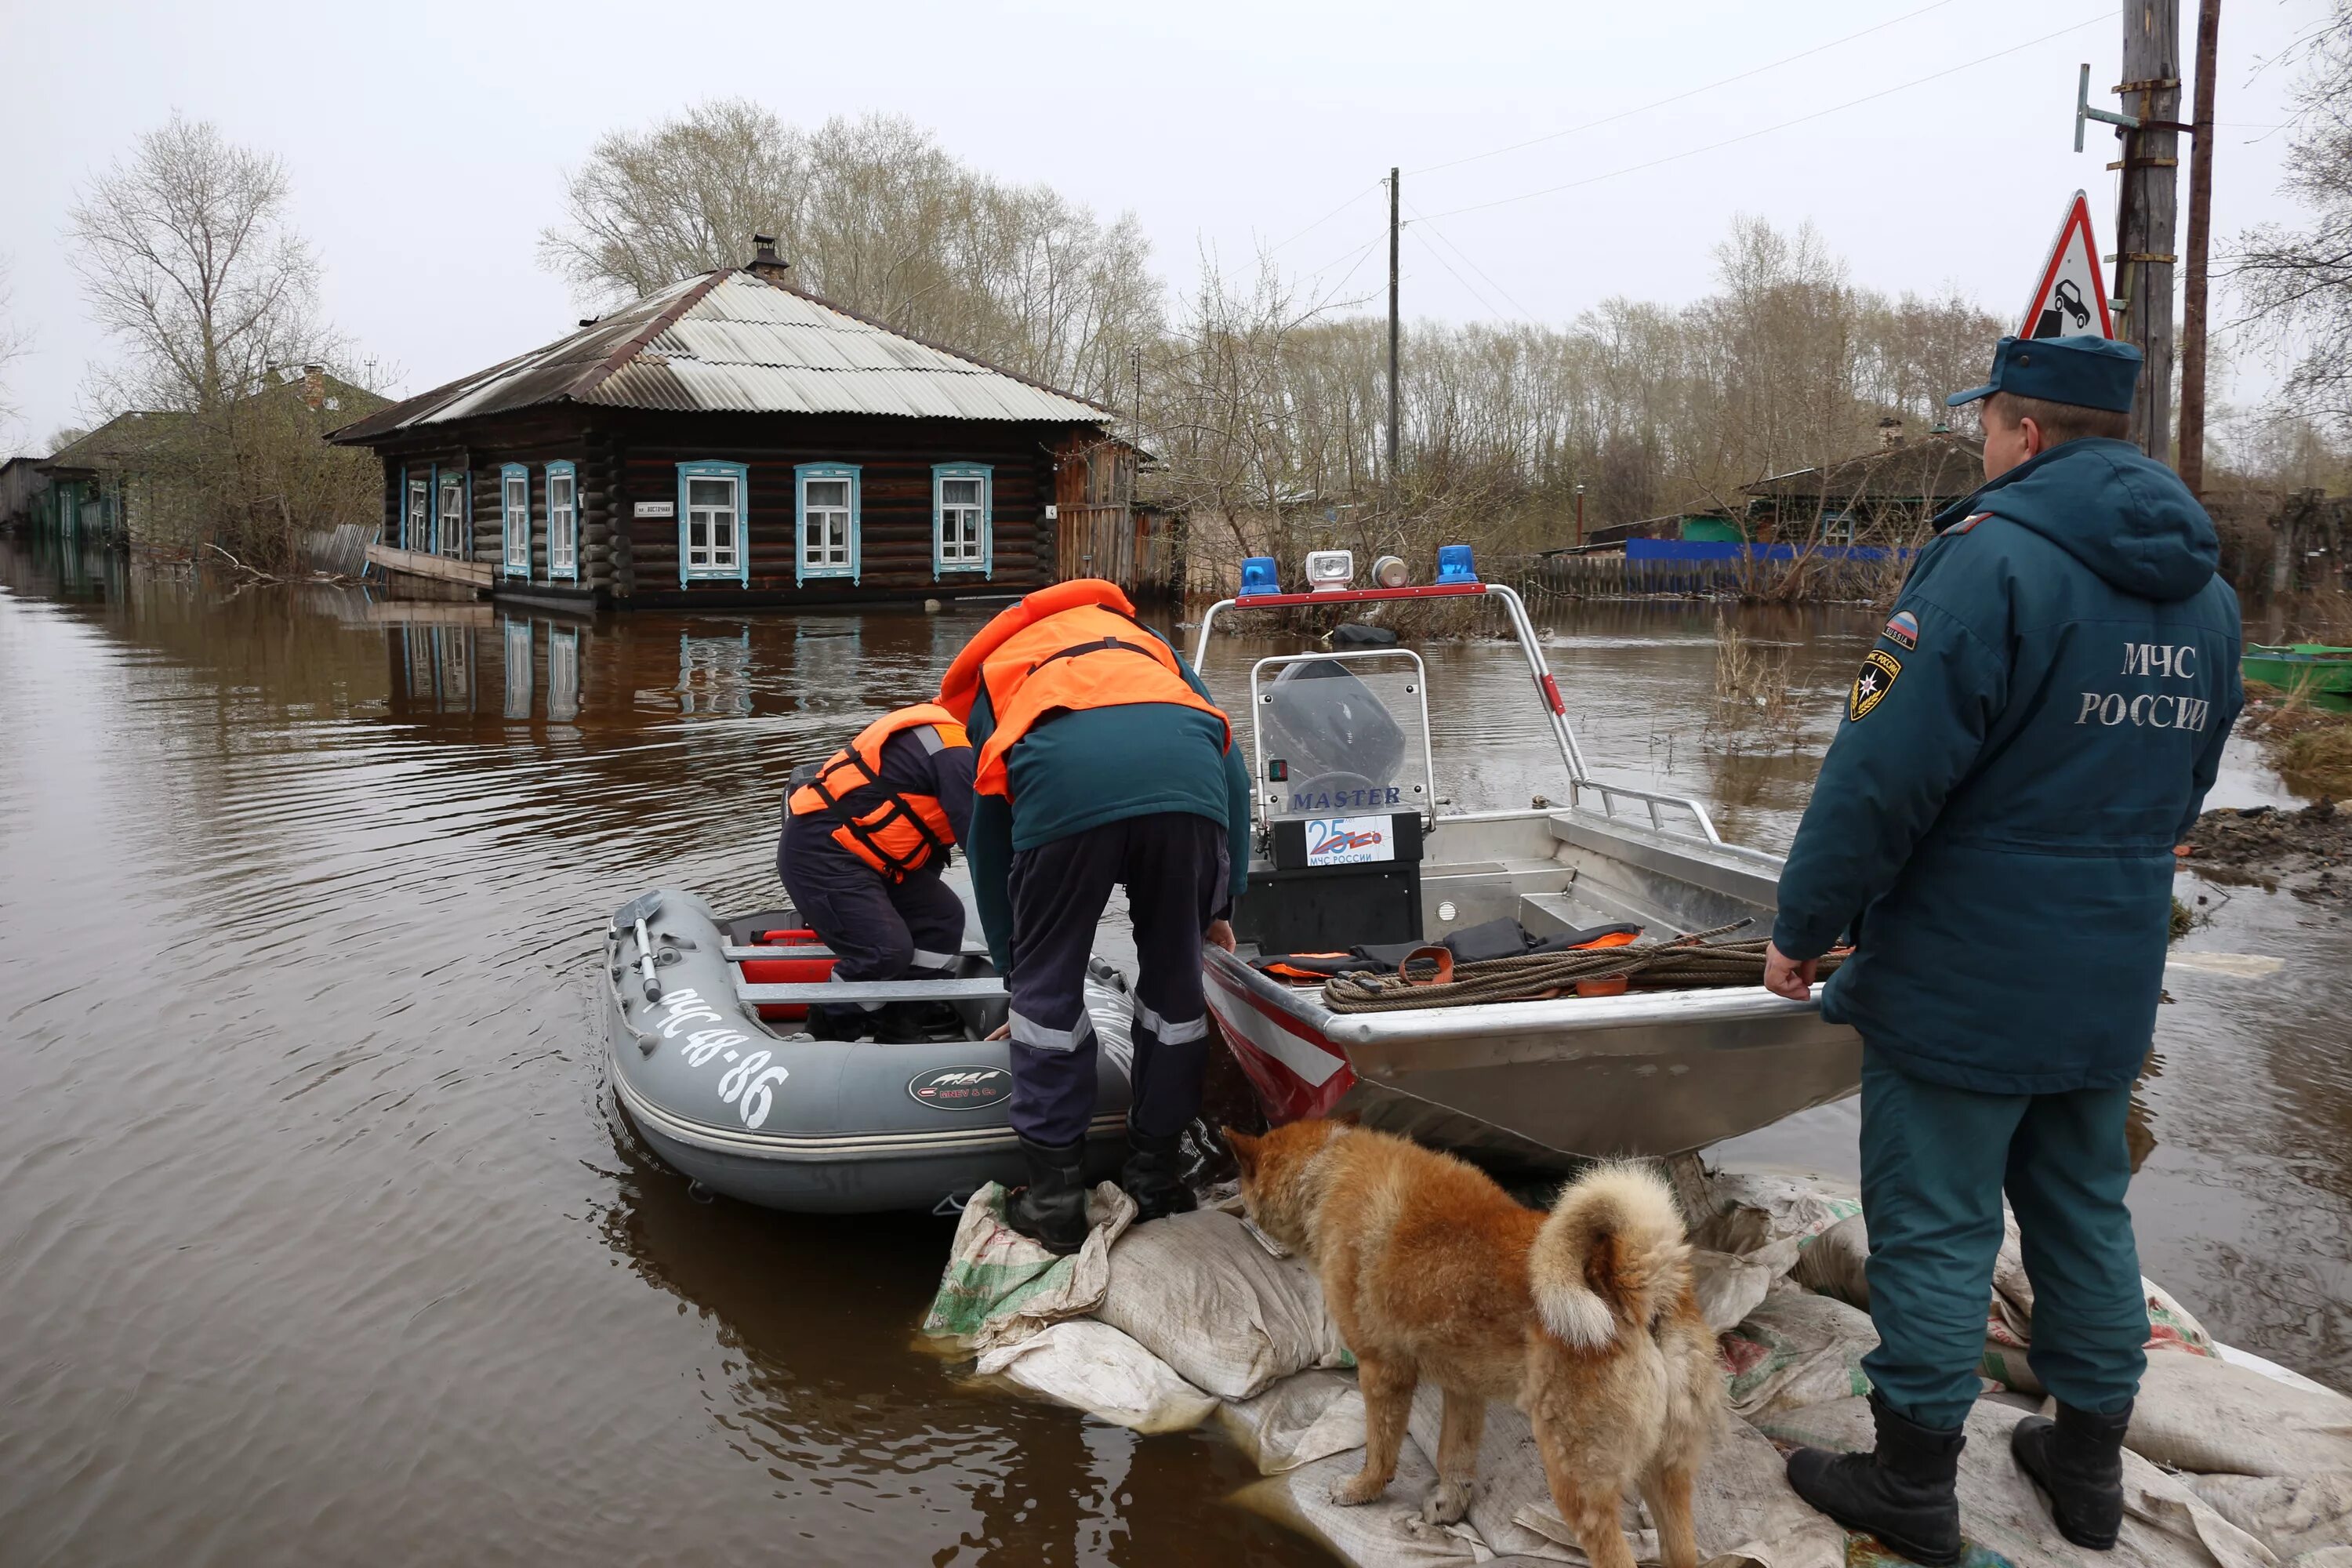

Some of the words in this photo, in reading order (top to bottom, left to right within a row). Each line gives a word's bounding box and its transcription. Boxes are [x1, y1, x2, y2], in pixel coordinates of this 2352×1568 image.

[1050, 508, 1054, 517] 4
[1885, 627, 1908, 644] RUSSIA
[1876, 655, 1898, 675] РОССИИ
[2120, 642, 2196, 679] МЧС
[2074, 692, 2210, 732] РОССИИ
[1293, 787, 1400, 810] MASTER
[1308, 819, 1348, 855] 25
[1310, 856, 1331, 866] МЧС
[1333, 853, 1372, 864] РОССИИ
[680, 1029, 790, 1131] 48-86
[940, 1089, 970, 1098] MNEV
[972, 1088, 981, 1097] &
